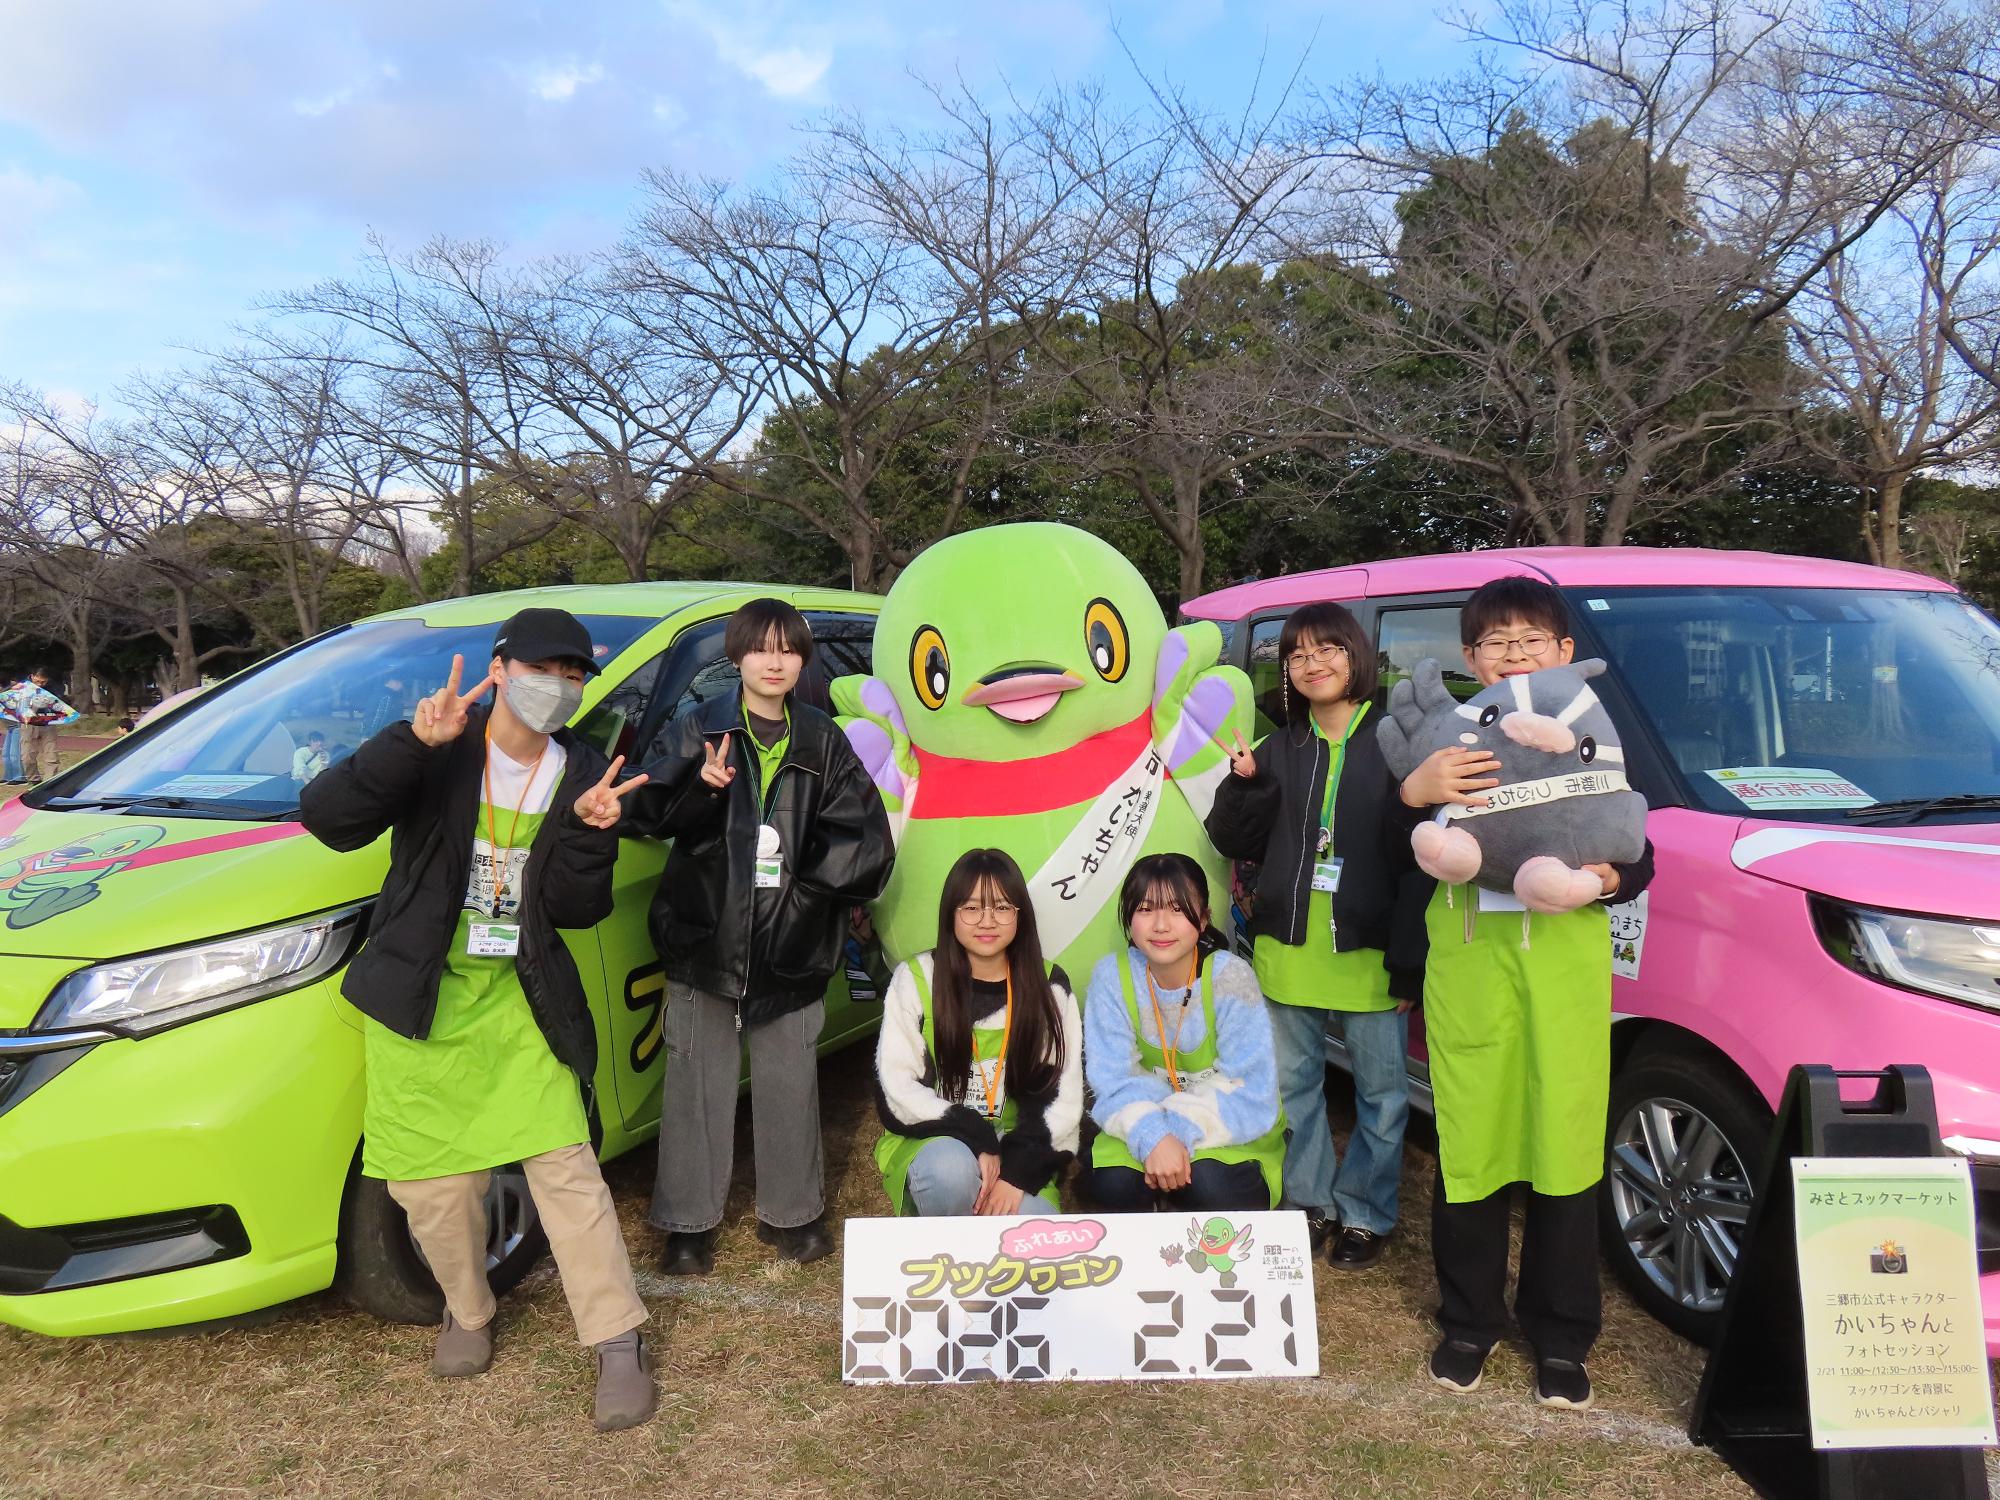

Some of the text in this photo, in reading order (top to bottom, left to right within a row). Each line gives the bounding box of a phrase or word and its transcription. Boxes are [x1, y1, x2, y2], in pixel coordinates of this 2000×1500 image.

[1564, 774, 1610, 793] 三郷市
[1726, 782, 1867, 798] 通行許可証
[1051, 786, 1141, 901] かいちゃん
[1014, 1228, 1094, 1254] ふれあい
[903, 1254, 1121, 1298] ブックワゴン
[1826, 1292, 1958, 1306] 三郷市公式キャラクター
[1834, 1312, 1955, 1335] かいちゃんと
[1844, 1344, 1951, 1358] フォトセッション
